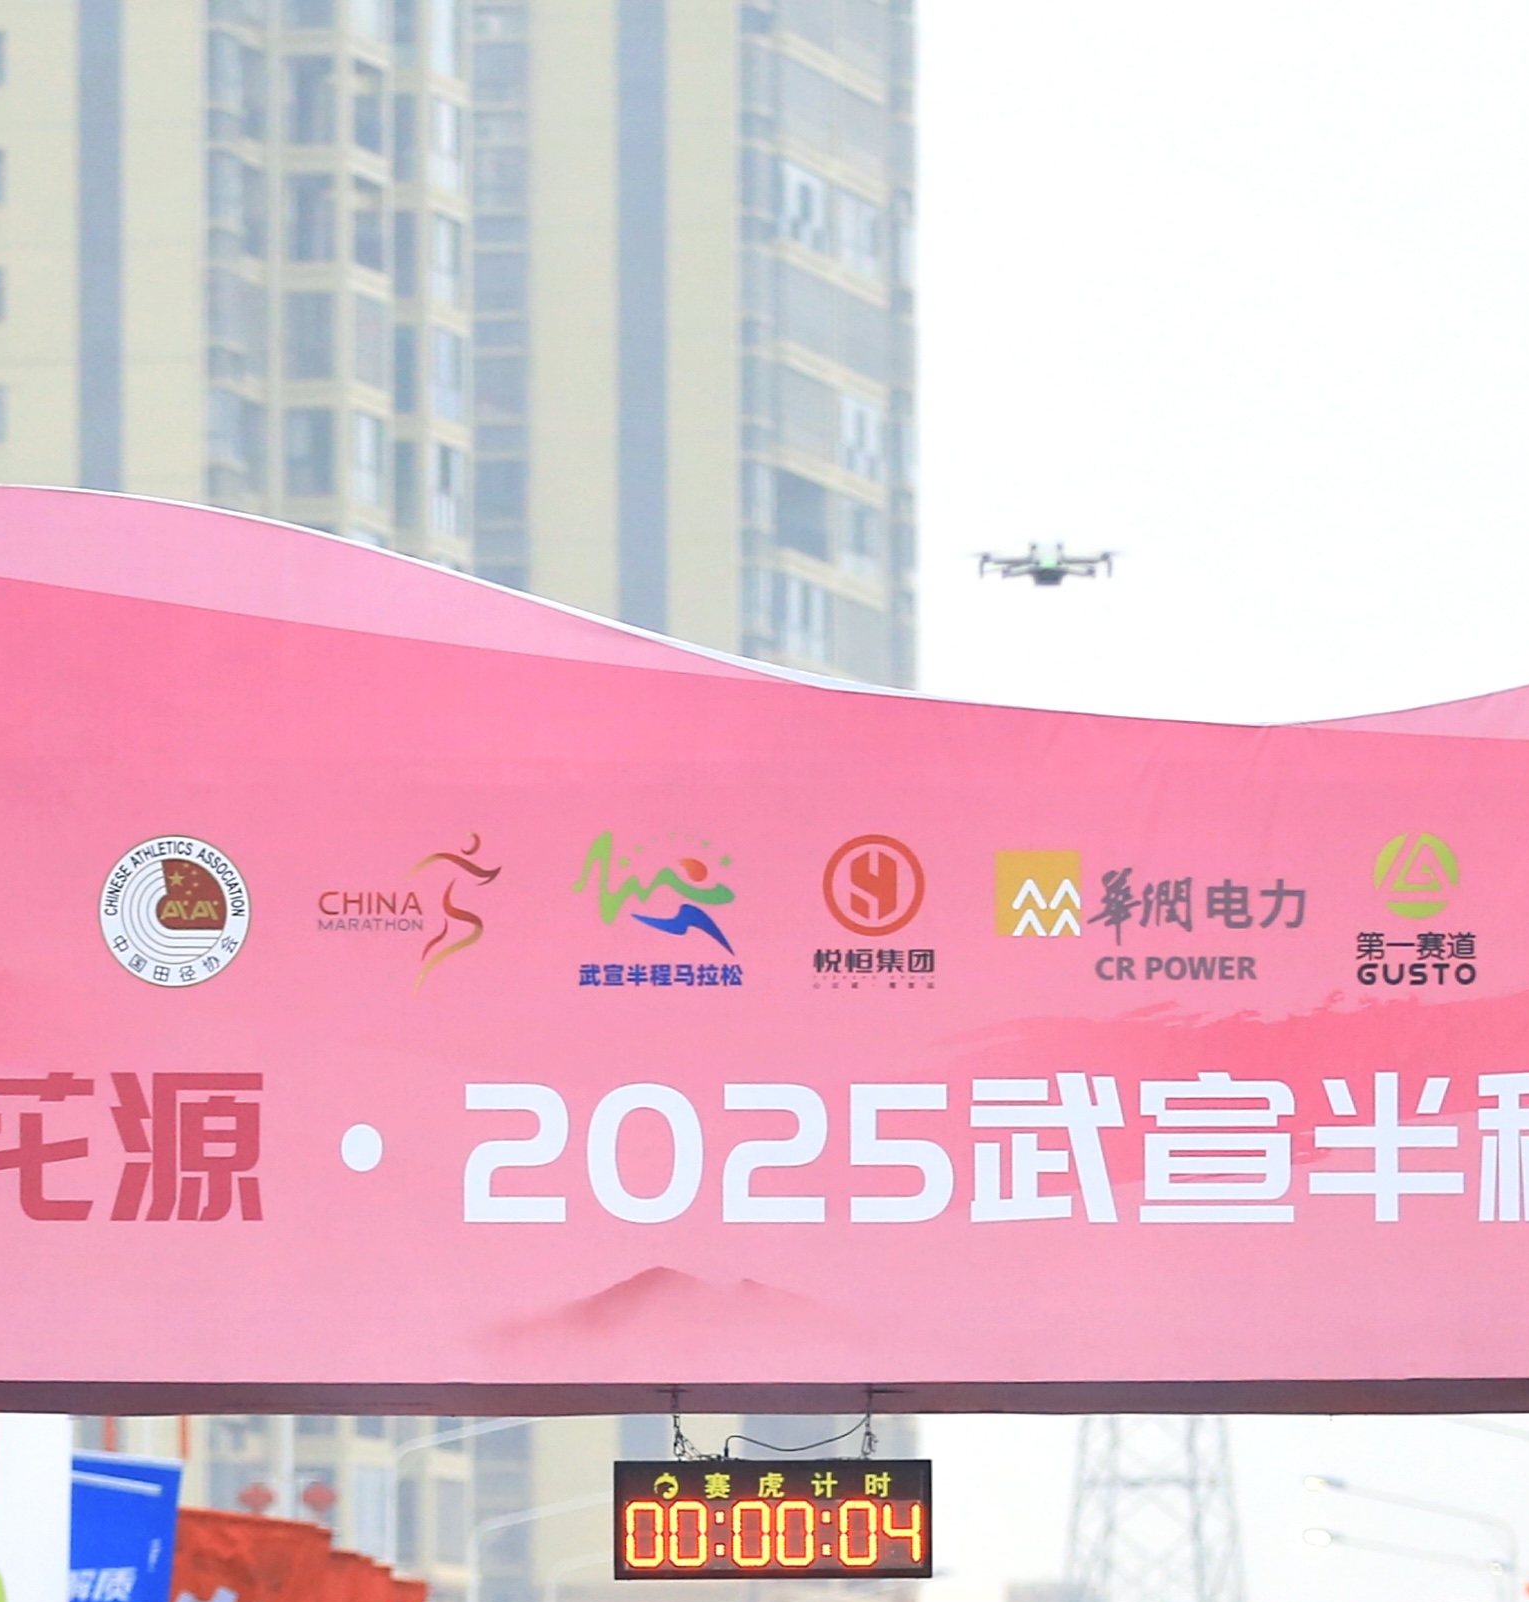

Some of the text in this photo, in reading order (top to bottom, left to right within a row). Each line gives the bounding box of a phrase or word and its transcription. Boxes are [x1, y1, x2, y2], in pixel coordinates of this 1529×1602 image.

[103, 840, 246, 919] CHINESE ATHLETICS ASSOCIATION
[318, 891, 424, 916] CHINA
[318, 918, 424, 932] MARATHON
[112, 933, 239, 983] 中国田径协会
[1355, 931, 1478, 960] 第一赛道
[813, 948, 936, 974] 悦恒集团
[1094, 955, 1257, 981] CR POWER
[578, 964, 744, 987] 武宣半程马拉松
[1356, 963, 1478, 986] GUSTO
[704, 1471, 893, 1499] 赛虎计时
[624, 1500, 924, 1569] 00:00:04
